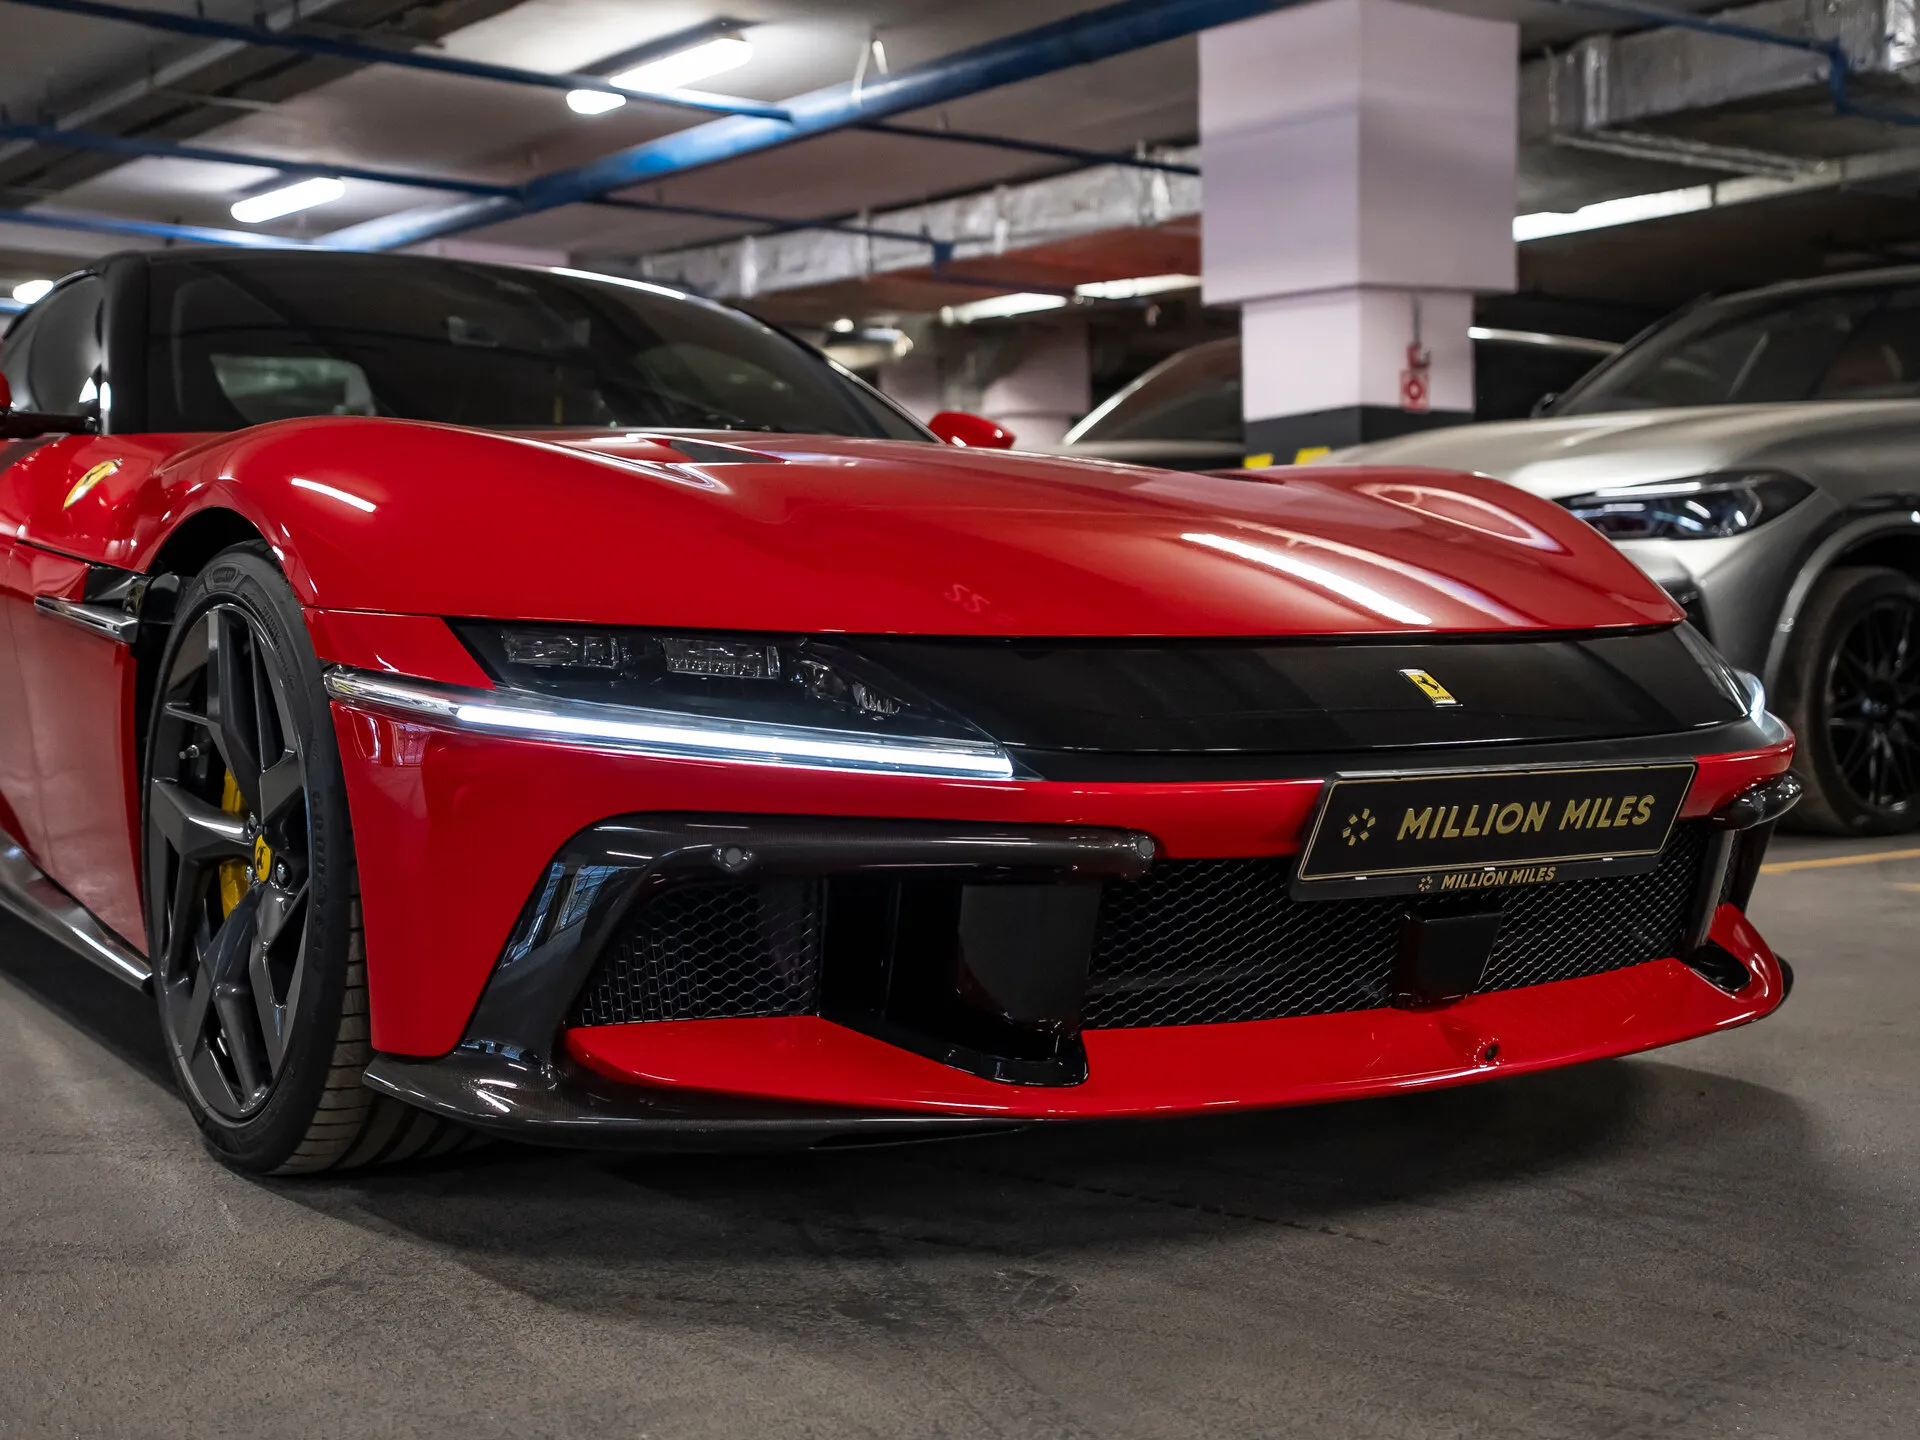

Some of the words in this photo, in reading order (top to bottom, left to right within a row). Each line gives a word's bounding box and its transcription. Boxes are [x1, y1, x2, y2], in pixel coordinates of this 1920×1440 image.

[1396, 800, 1551, 841] MILLION
[1558, 794, 1656, 831] MILES
[1440, 870, 1508, 890] MILLION
[1508, 866, 1557, 885] MILES
